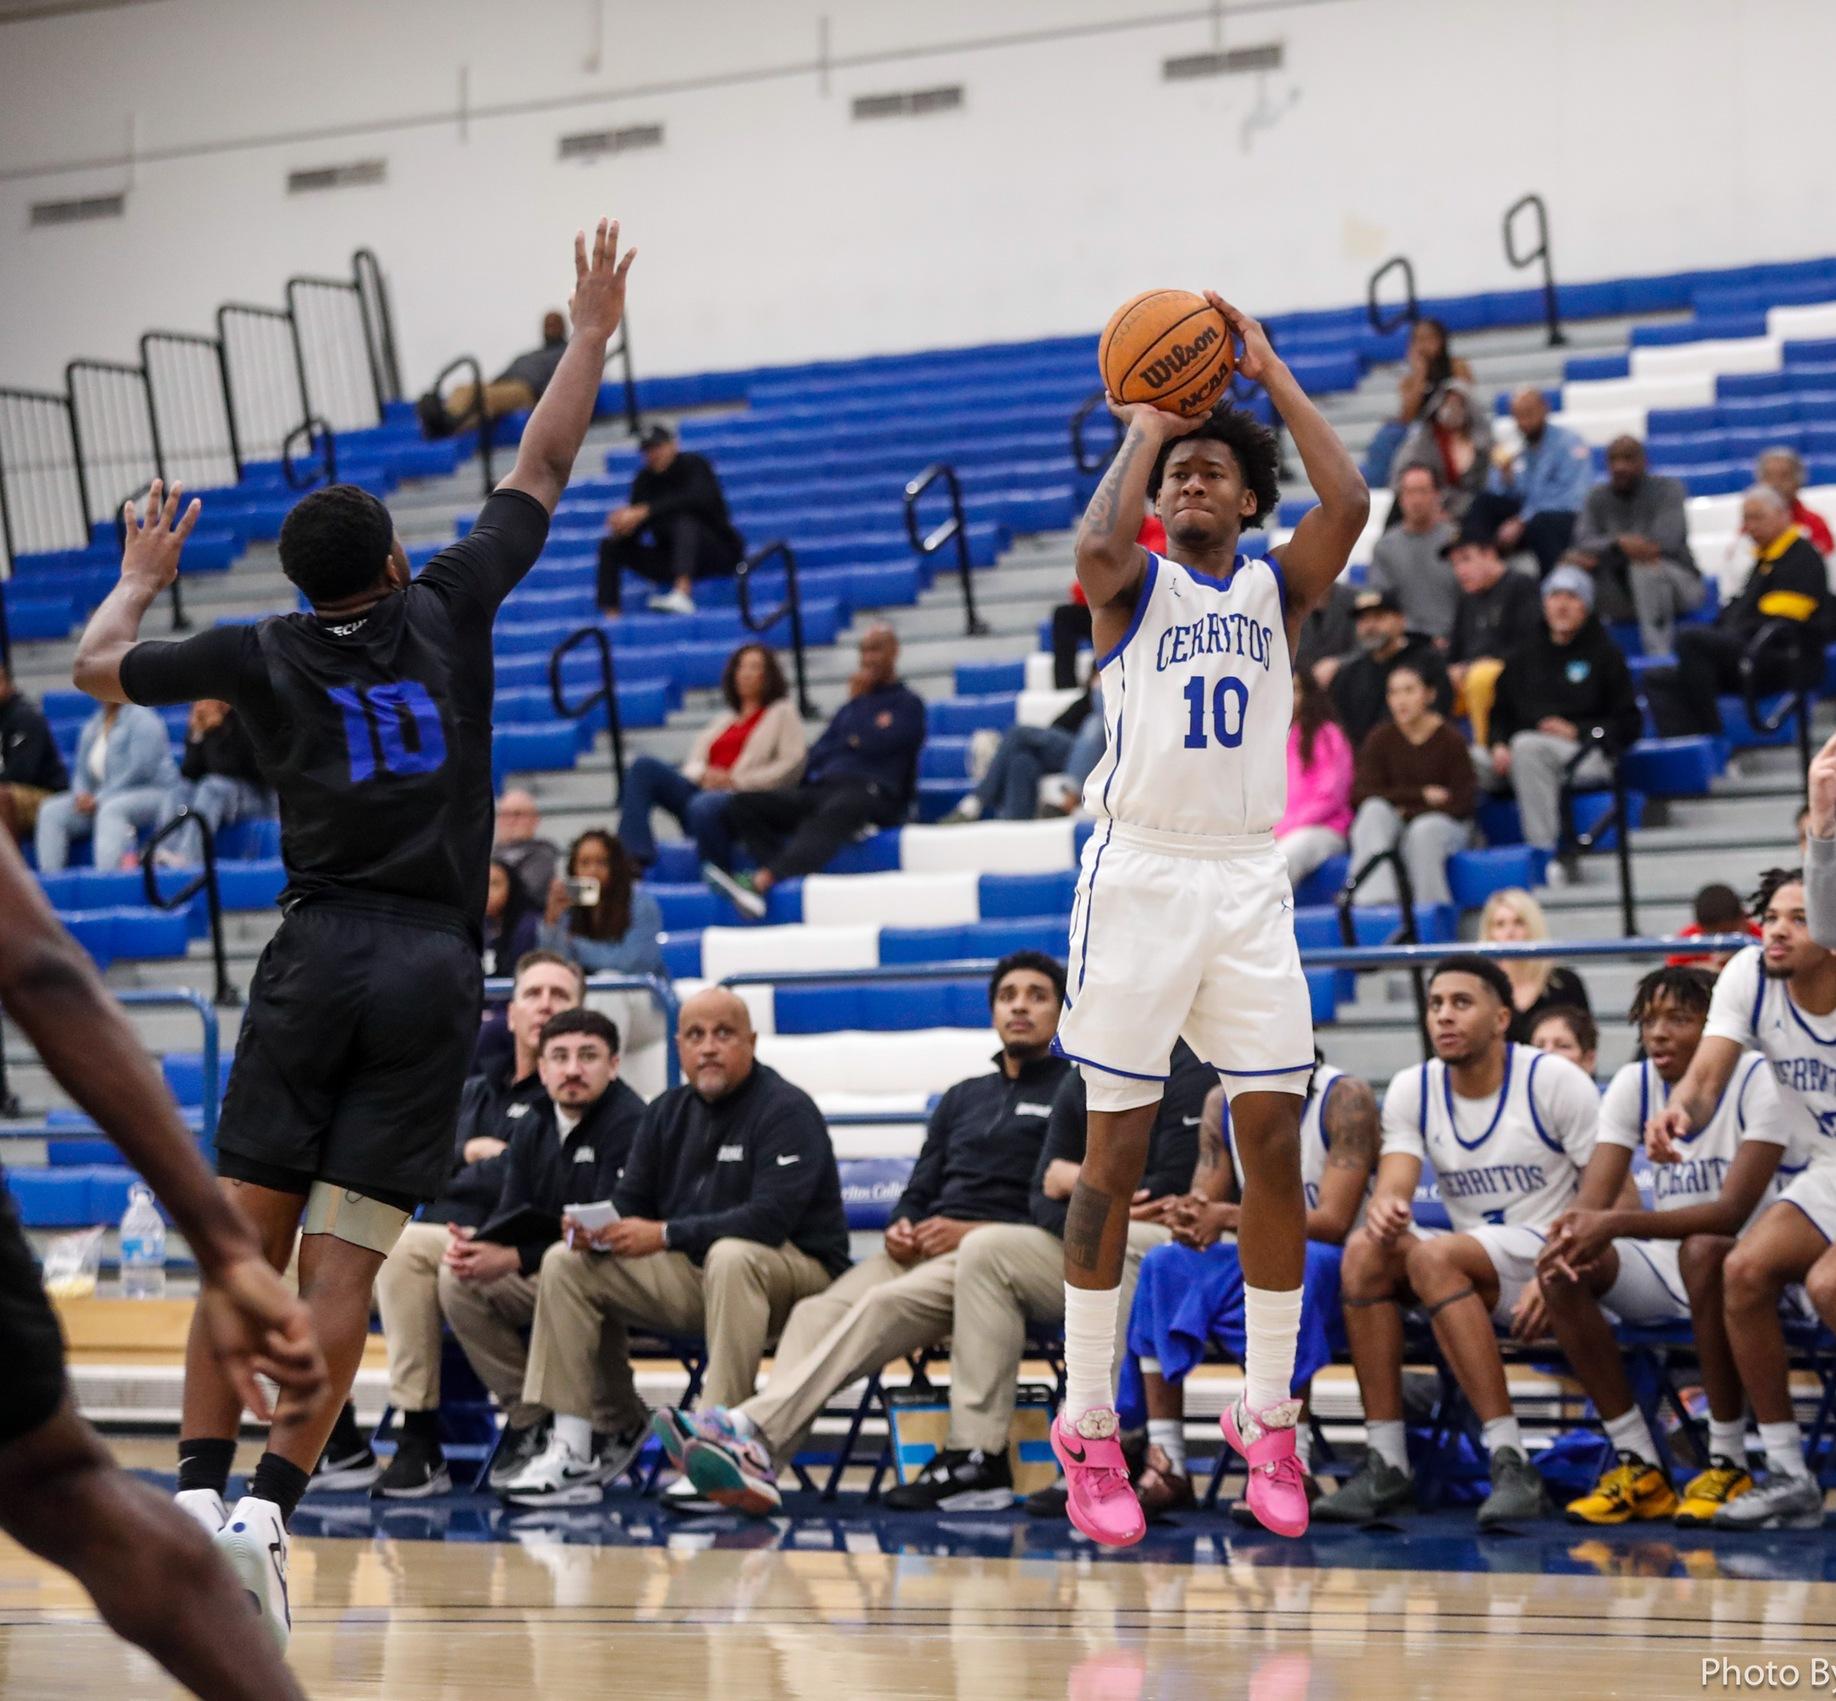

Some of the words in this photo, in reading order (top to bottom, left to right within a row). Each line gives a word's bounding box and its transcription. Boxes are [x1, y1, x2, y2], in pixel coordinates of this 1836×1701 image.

[1139, 326, 1220, 390] Wilson
[1156, 612, 1273, 672] CERRITOS
[326, 679, 447, 783] 10
[1183, 675, 1250, 749] 10
[1439, 1164, 1548, 1198] ERRITOS
